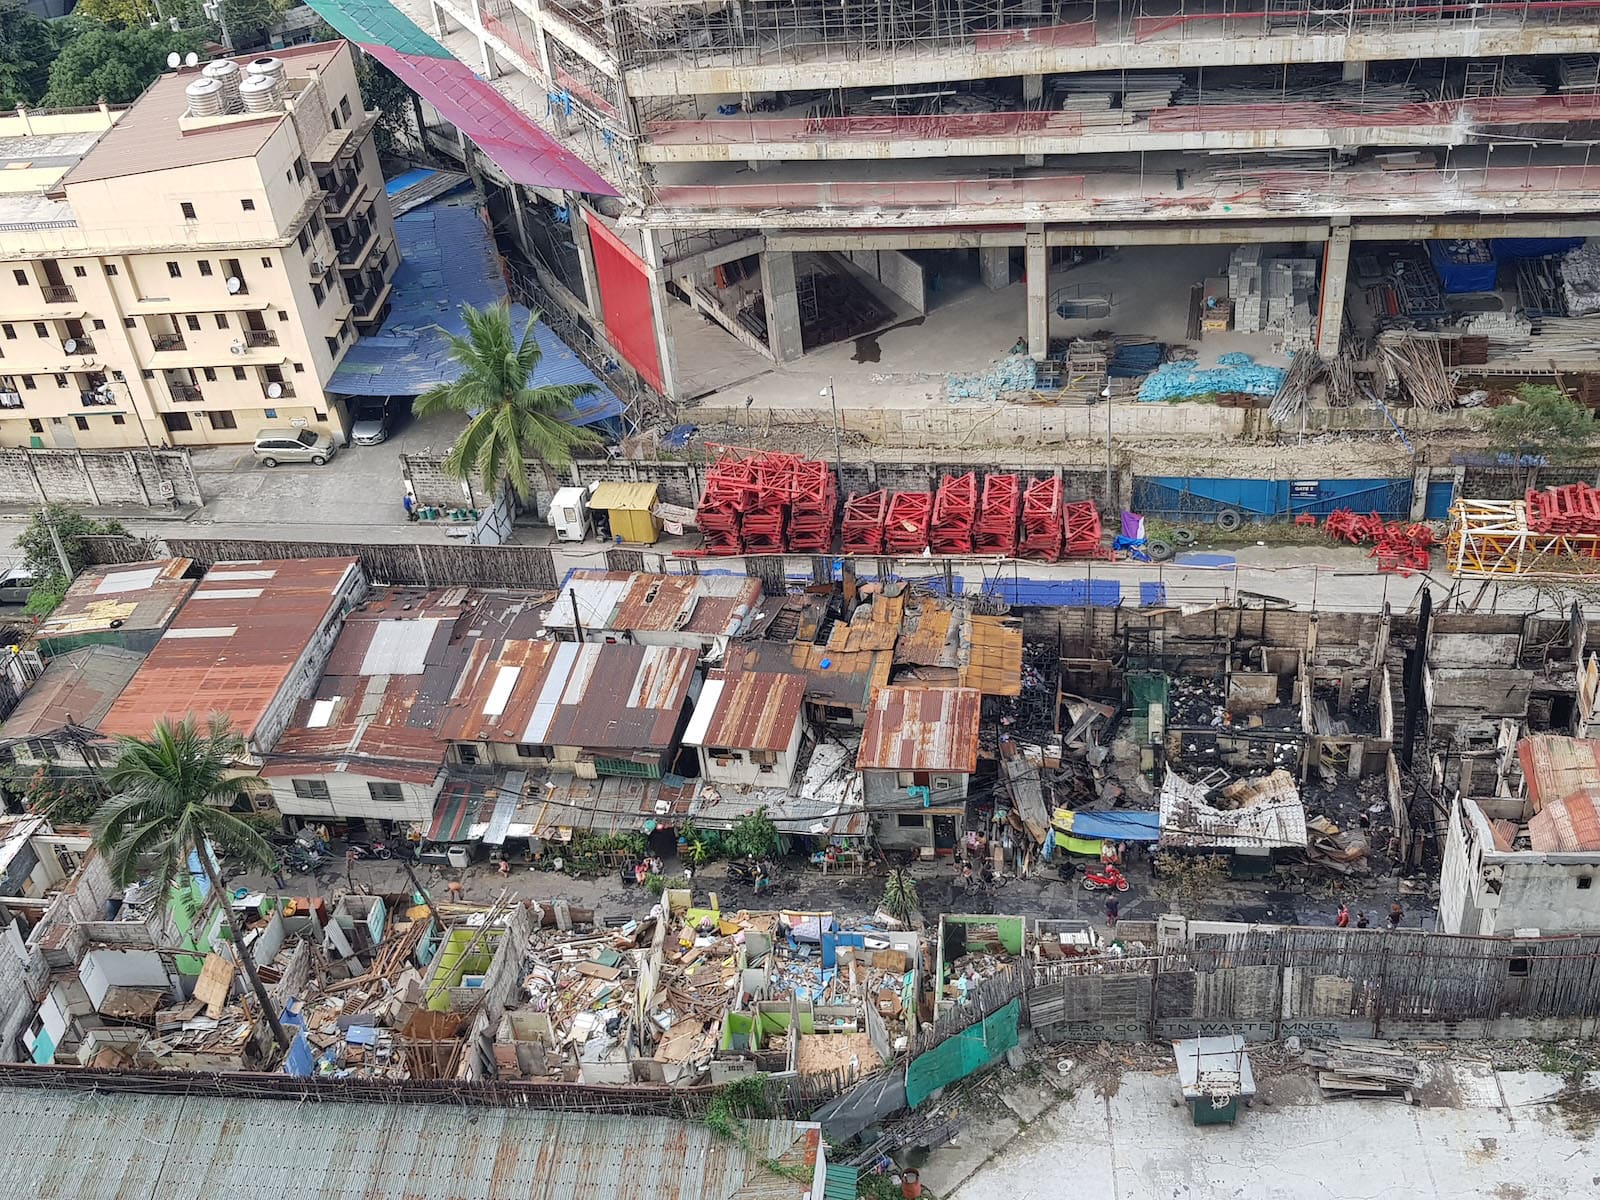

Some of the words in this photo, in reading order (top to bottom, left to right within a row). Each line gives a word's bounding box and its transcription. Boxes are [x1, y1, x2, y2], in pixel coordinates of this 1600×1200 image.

[1056, 1024, 1105, 1032] ZERO
[1200, 1023, 1272, 1031] WASTE
[1281, 1022, 1338, 1031] MNGT.
